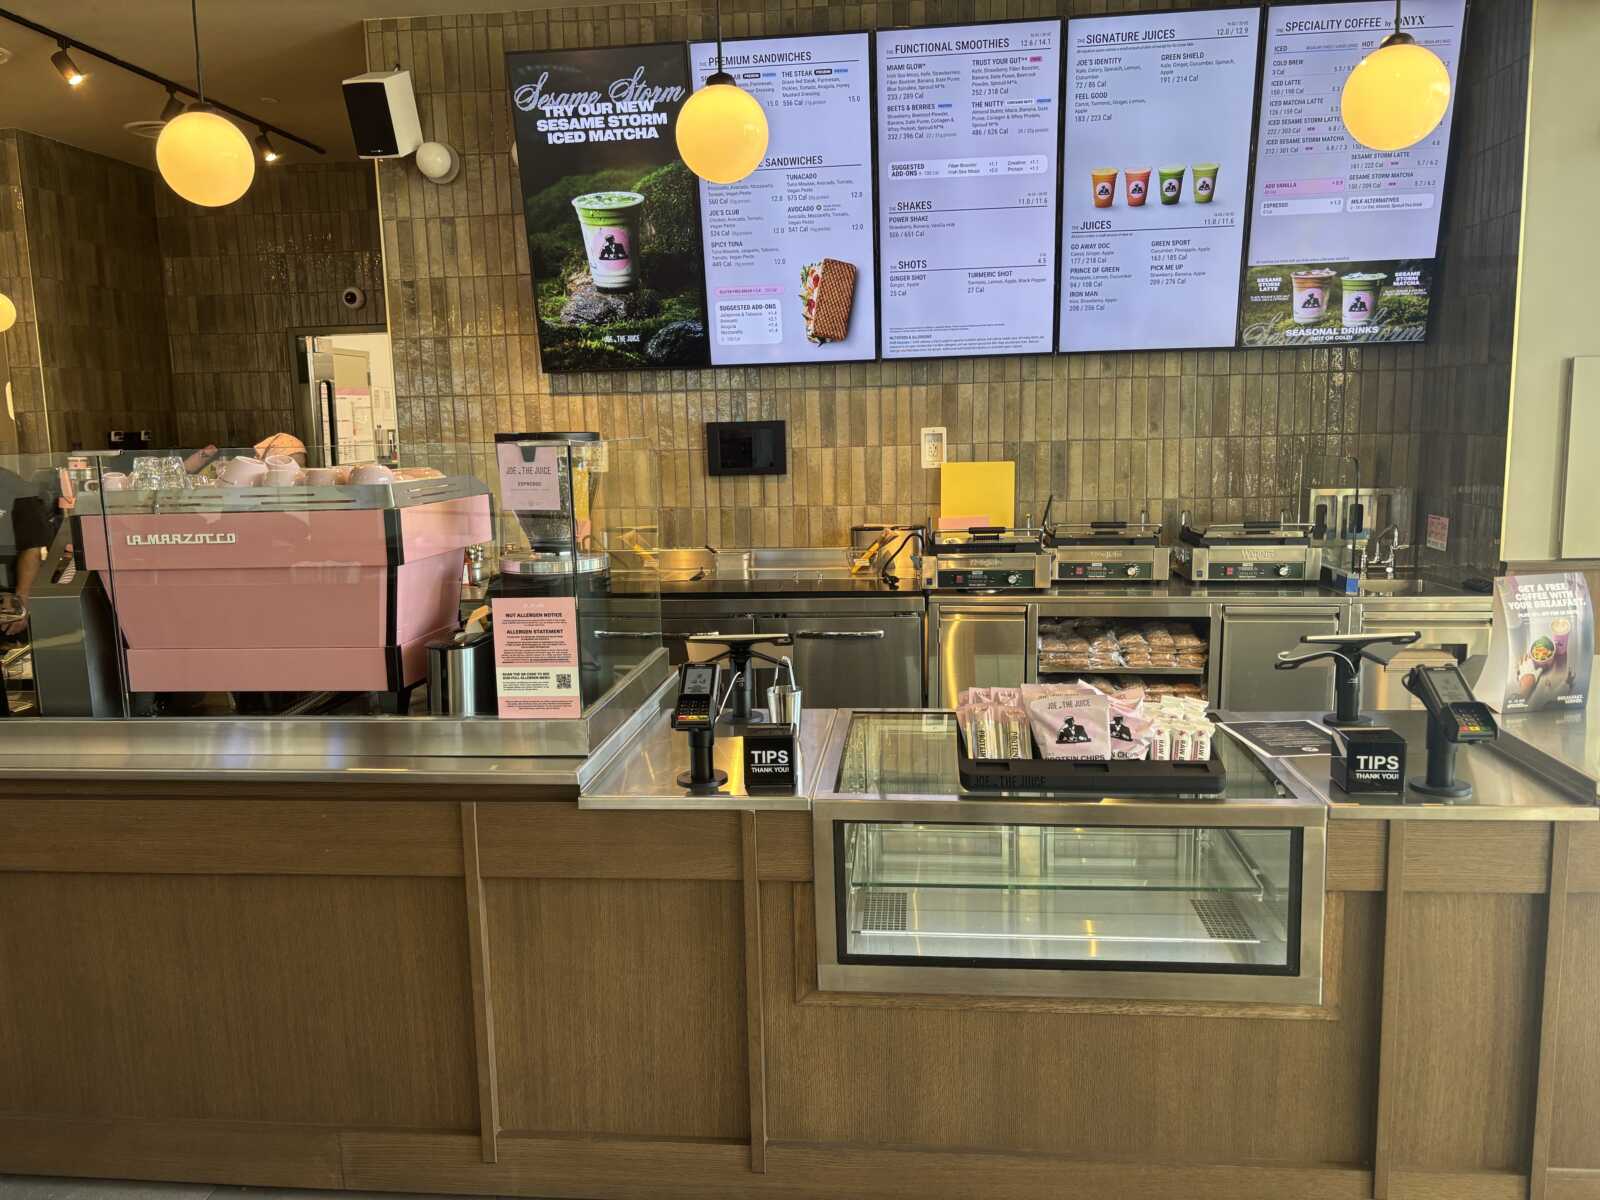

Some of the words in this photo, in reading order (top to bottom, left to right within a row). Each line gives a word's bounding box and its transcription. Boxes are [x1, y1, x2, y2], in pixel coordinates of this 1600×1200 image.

[1285, 19, 1342, 32] SPECIALITY
[1344, 17, 1382, 30] COFFEE
[1086, 31, 1139, 45] SIGNATURE
[1141, 29, 1176, 41] JUICES
[895, 41, 953, 54] FUNCTIONAL
[955, 38, 1010, 51] SMOOTHIES
[752, 51, 812, 65] SANDWICHES
[1160, 53, 1182, 61] GREEN
[1183, 51, 1205, 60] SHIELD
[972, 59, 990, 67] TRUST
[992, 58, 1008, 66] YOUR
[1076, 58, 1094, 67] JOE'S
[1094, 57, 1122, 65] IDENTITY
[1272, 59, 1288, 67] COLD
[1288, 58, 1304, 66] BREW
[886, 64, 905, 72] MIAMI
[781, 71, 793, 79] THE
[794, 69, 813, 78] STEAK
[1188, 74, 1199, 82] Cal
[514, 72, 601, 112] Sesame
[608, 66, 686, 103] Storm
[984, 100, 1004, 108] NUTTY
[1269, 99, 1282, 107] ICED
[1282, 98, 1306, 106] MATCHA
[1306, 97, 1324, 105] LATTE
[544, 104, 574, 118] TRY
[578, 103, 613, 116] OUR
[616, 100, 655, 114] NEW
[887, 104, 905, 112] BEETS
[911, 103, 936, 111] BERRIES
[536, 117, 605, 132] SESAME
[608, 113, 668, 128] STORM
[1267, 118, 1281, 126] ICED
[1282, 117, 1303, 125] SESAME
[1304, 116, 1323, 124] STORM
[547, 131, 586, 145] ICED
[588, 127, 660, 142] MATCHA
[1279, 137, 1301, 145] SESAME
[1321, 135, 1345, 143] MATCHA
[765, 155, 823, 167] SANDWICHES
[1351, 152, 1372, 161] SESAME
[891, 163, 925, 171] SUGGESTED
[786, 172, 818, 181] TUNACADO
[1349, 173, 1371, 181] SESAME
[1371, 172, 1390, 180] STORM
[1390, 171, 1414, 179] MATCHA
[787, 205, 815, 213] AVOCADO
[897, 200, 932, 211] SHAKES
[888, 215, 909, 223] POWER
[1080, 220, 1112, 231] JUICES
[726, 240, 743, 248] TUNA
[1171, 239, 1191, 247] SPORT
[898, 259, 928, 270] SHOTS
[1070, 266, 1091, 274] PRINCE
[1100, 265, 1120, 273] GREEN
[1165, 263, 1174, 271] ME
[889, 274, 911, 282] GINGER
[967, 271, 996, 279] TURMERIC
[975, 286, 985, 294] Cal
[719, 303, 751, 312] SUGGESTED
[1285, 328, 1340, 337] SEASONAL
[1342, 326, 1379, 335] DRINKS
[521, 466, 534, 475] THE
[534, 466, 552, 475] JUICE
[126, 534, 142, 546] LA
[146, 533, 236, 545] MARZOCCO
[1518, 584, 1536, 593] GET
[1537, 583, 1546, 592] A
[1546, 582, 1569, 591] FREE
[1515, 591, 1549, 600] COFFEE
[1549, 590, 1574, 599] WITH
[1507, 601, 1533, 611] YOUR
[1062, 700, 1073, 709] THE
[1075, 699, 1091, 708] JUICE
[751, 750, 789, 764] TIPS
[1356, 755, 1400, 770] TIPS
[751, 766, 774, 774] THANK
[999, 775, 1017, 785] THE
[1021, 775, 1047, 785] JUICE
